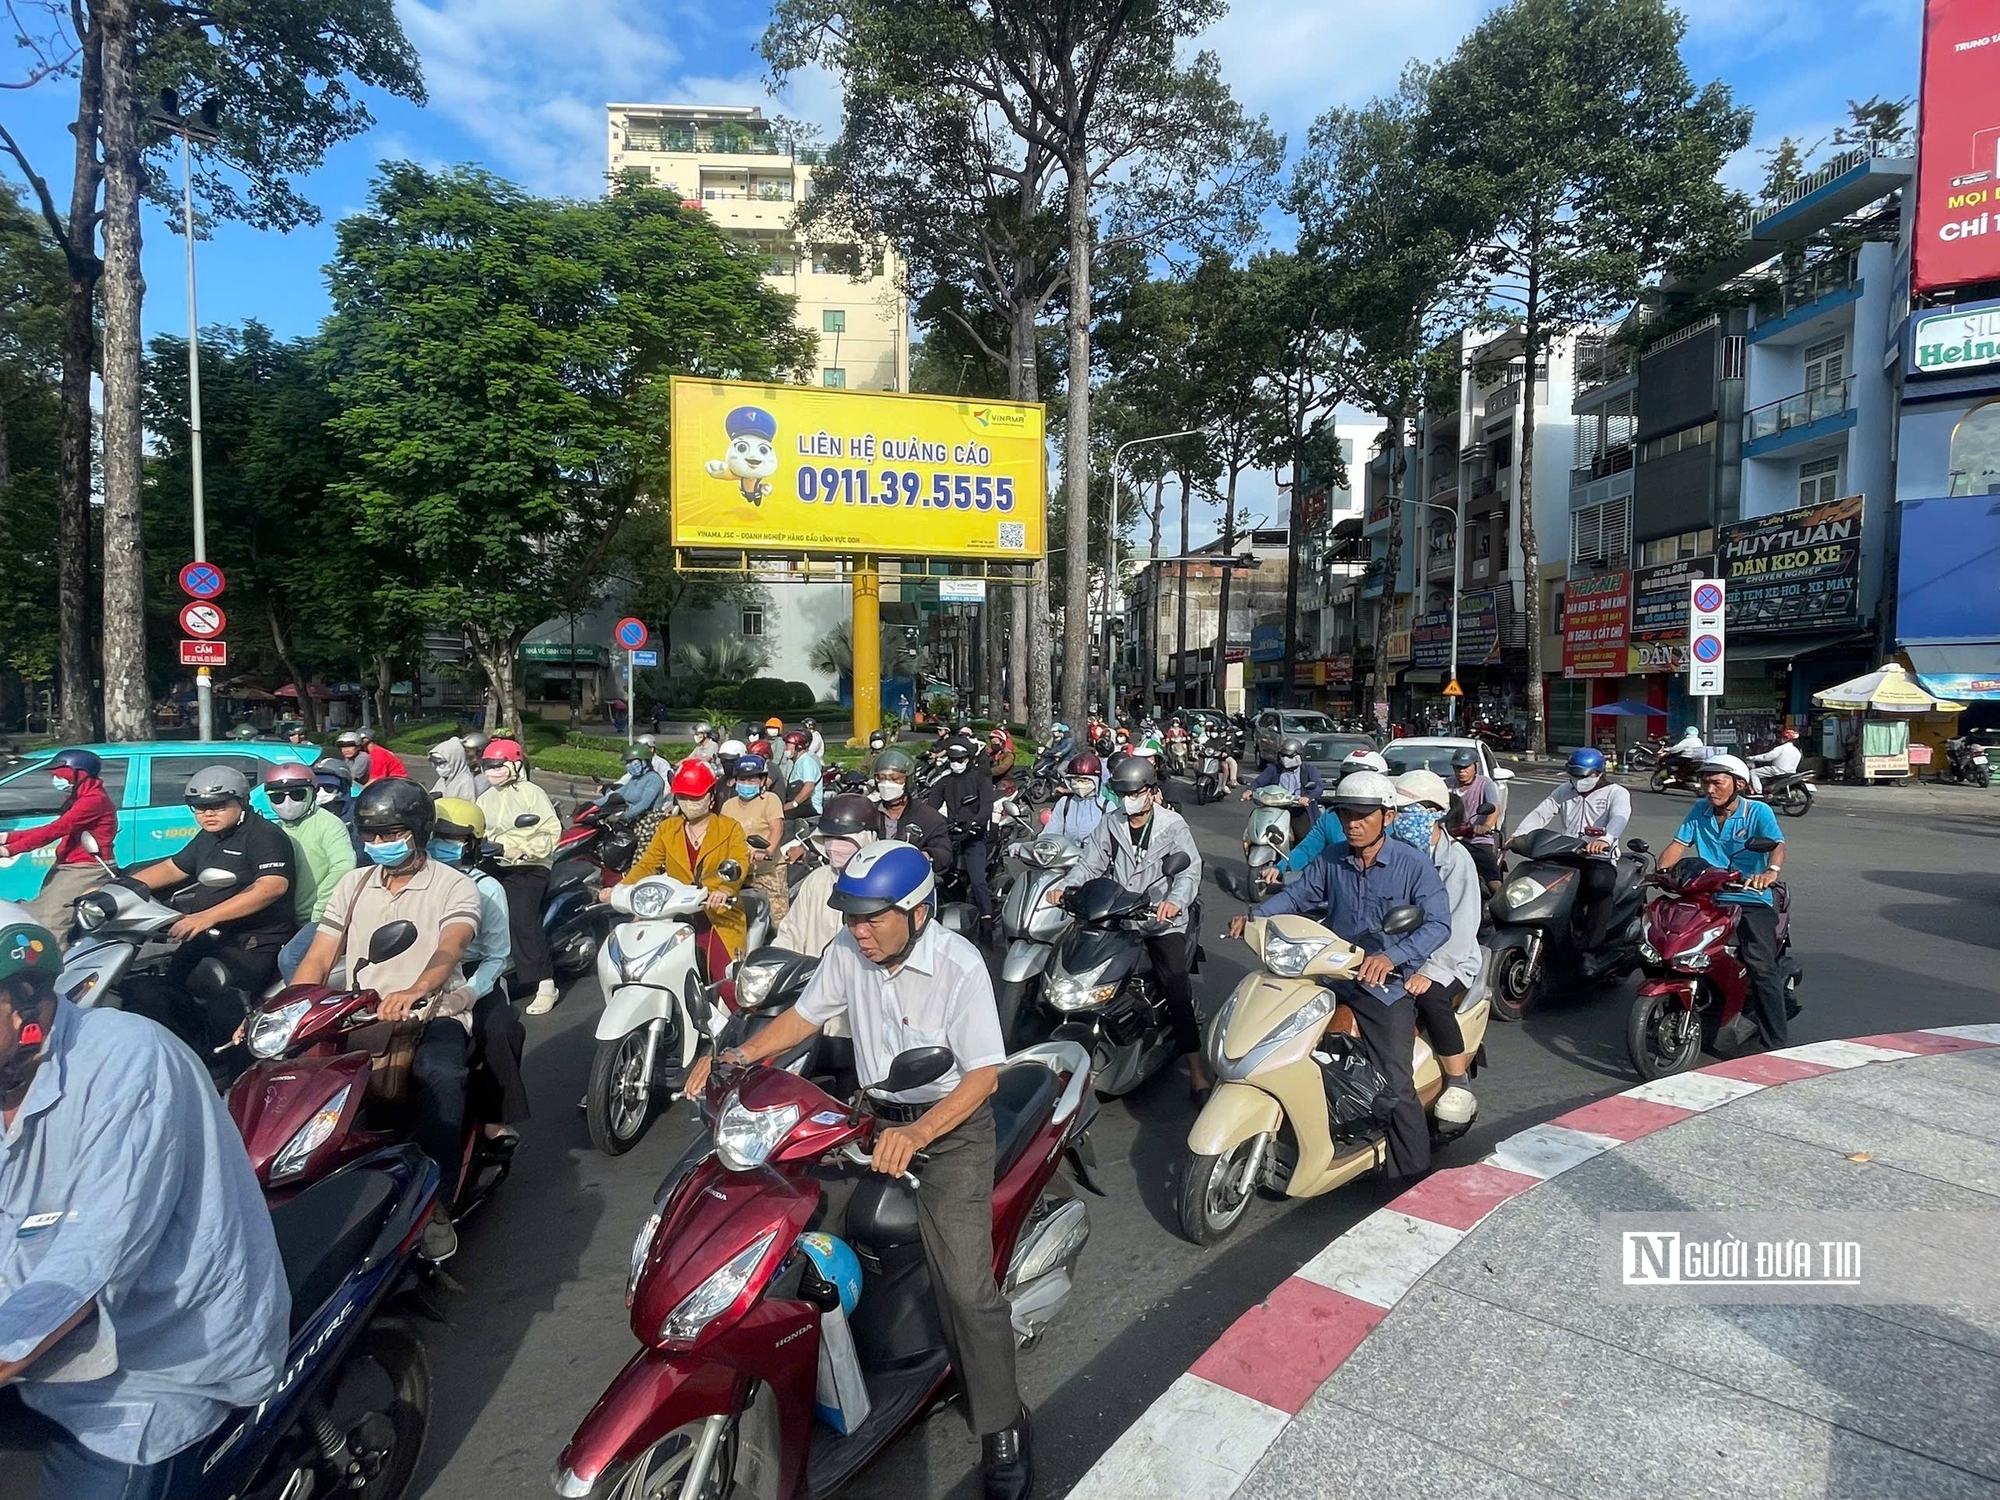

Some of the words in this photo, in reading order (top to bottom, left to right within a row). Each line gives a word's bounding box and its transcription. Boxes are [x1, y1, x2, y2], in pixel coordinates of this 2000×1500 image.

[1954, 37, 1990, 52] TRUNG
[1948, 189, 1987, 209] MỌI
[1939, 212, 1988, 241] CHỈ
[799, 431, 842, 456] LIÊN
[850, 434, 875, 464] HỆ
[882, 437, 947, 462] QUẢNG
[954, 440, 989, 464] CÁO
[798, 466, 1014, 511] 0911.39.5555
[697, 530, 721, 538] VINAMA
[741, 532, 762, 540] DOANH
[763, 532, 786, 542] NGHIỆP
[787, 533, 805, 541] HÀNG
[819, 533, 834, 543] LĨNH
[1731, 555, 1769, 577] DÁN
[1771, 550, 1810, 572] KEO
[1813, 545, 1841, 565] XE
[1785, 566, 1822, 579] NGHIỆP
[1742, 589, 1764, 600] TEM
[1765, 587, 1780, 598] XE
[1808, 581, 1825, 592] XE
[1827, 576, 1854, 591] MÁY
[194, 643, 212, 654] CẤM
[525, 647, 538, 655] NHÀ
[537, 646, 546, 655] VỆ
[1639, 642, 1674, 665] DÁN
[774, 1323, 814, 1349] HONDA
